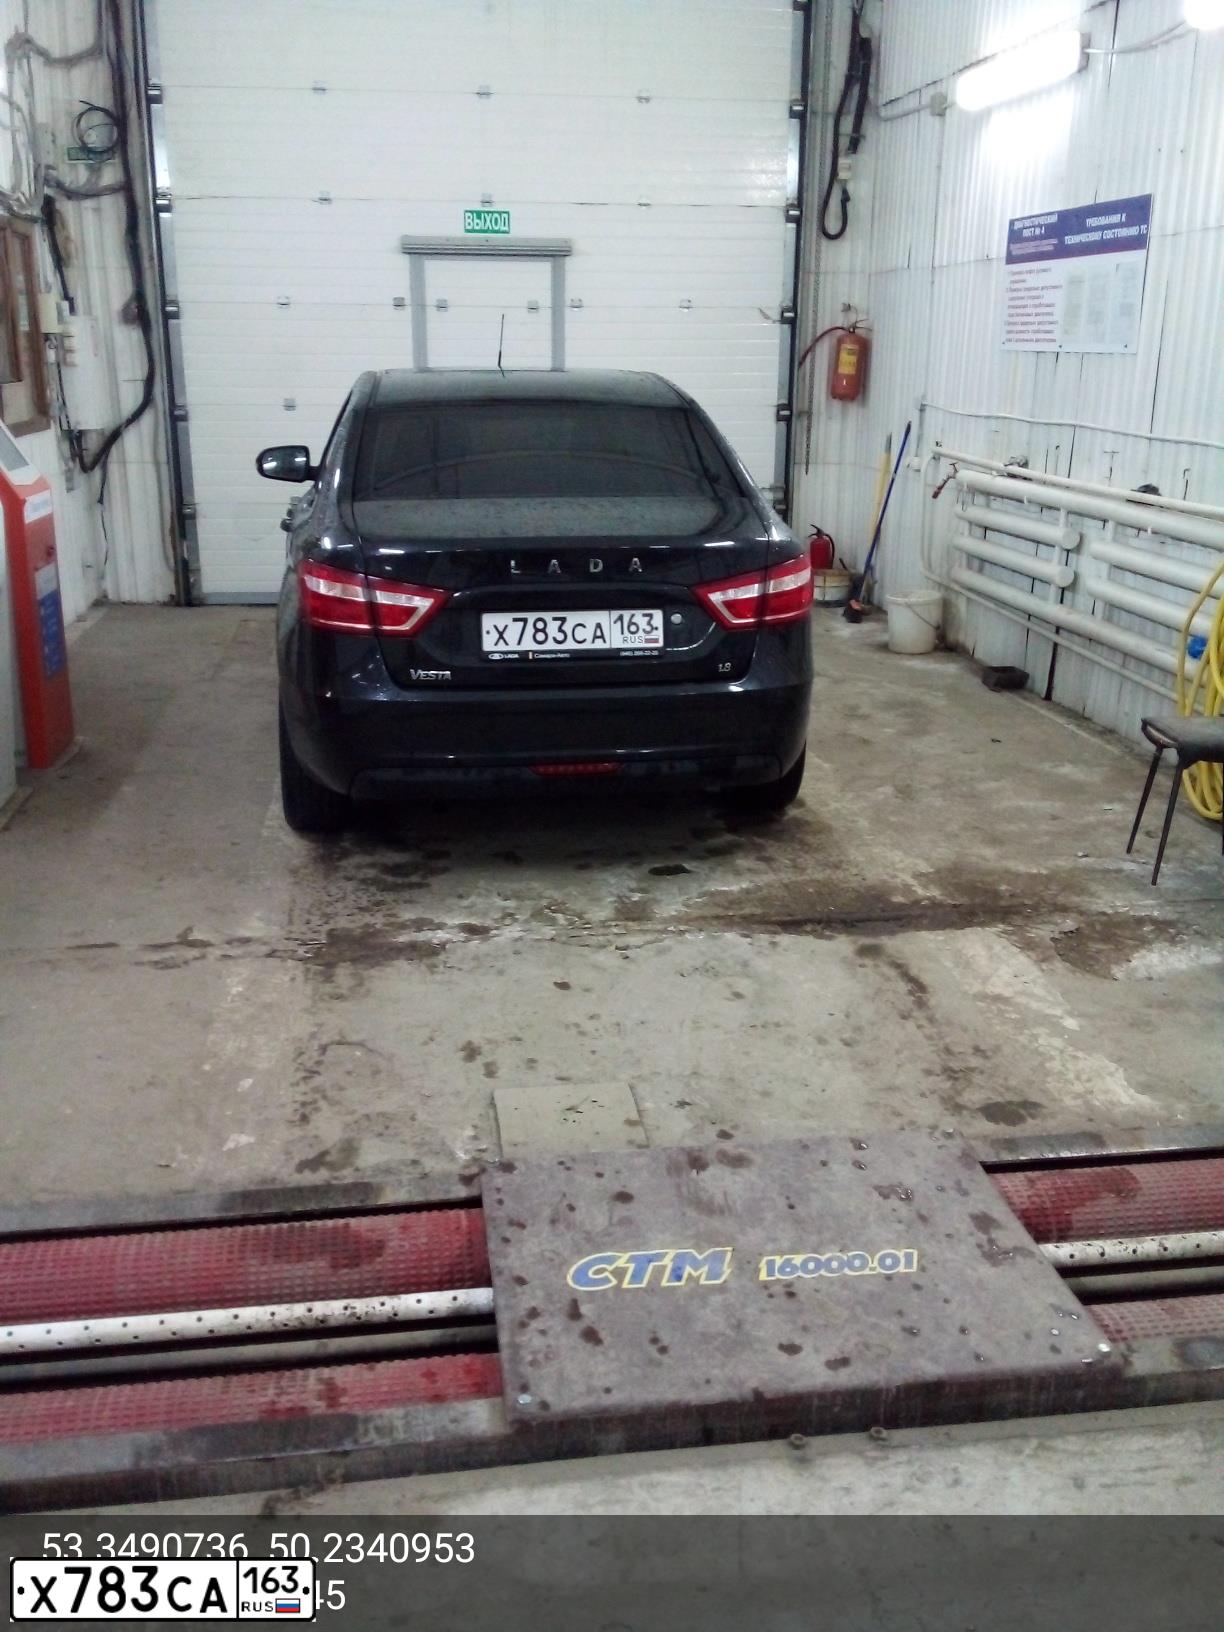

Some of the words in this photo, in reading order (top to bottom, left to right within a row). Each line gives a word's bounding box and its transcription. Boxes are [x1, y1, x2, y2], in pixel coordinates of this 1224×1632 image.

[465, 212, 510, 231] ВЫХОД
[1102, 226, 1140, 239] СОСТОЯНИЮ
[510, 557, 642, 573] LADA
[613, 612, 654, 635] 163
[623, 636, 644, 644] RUS
[759, 1249, 918, 1281] 16000.01
